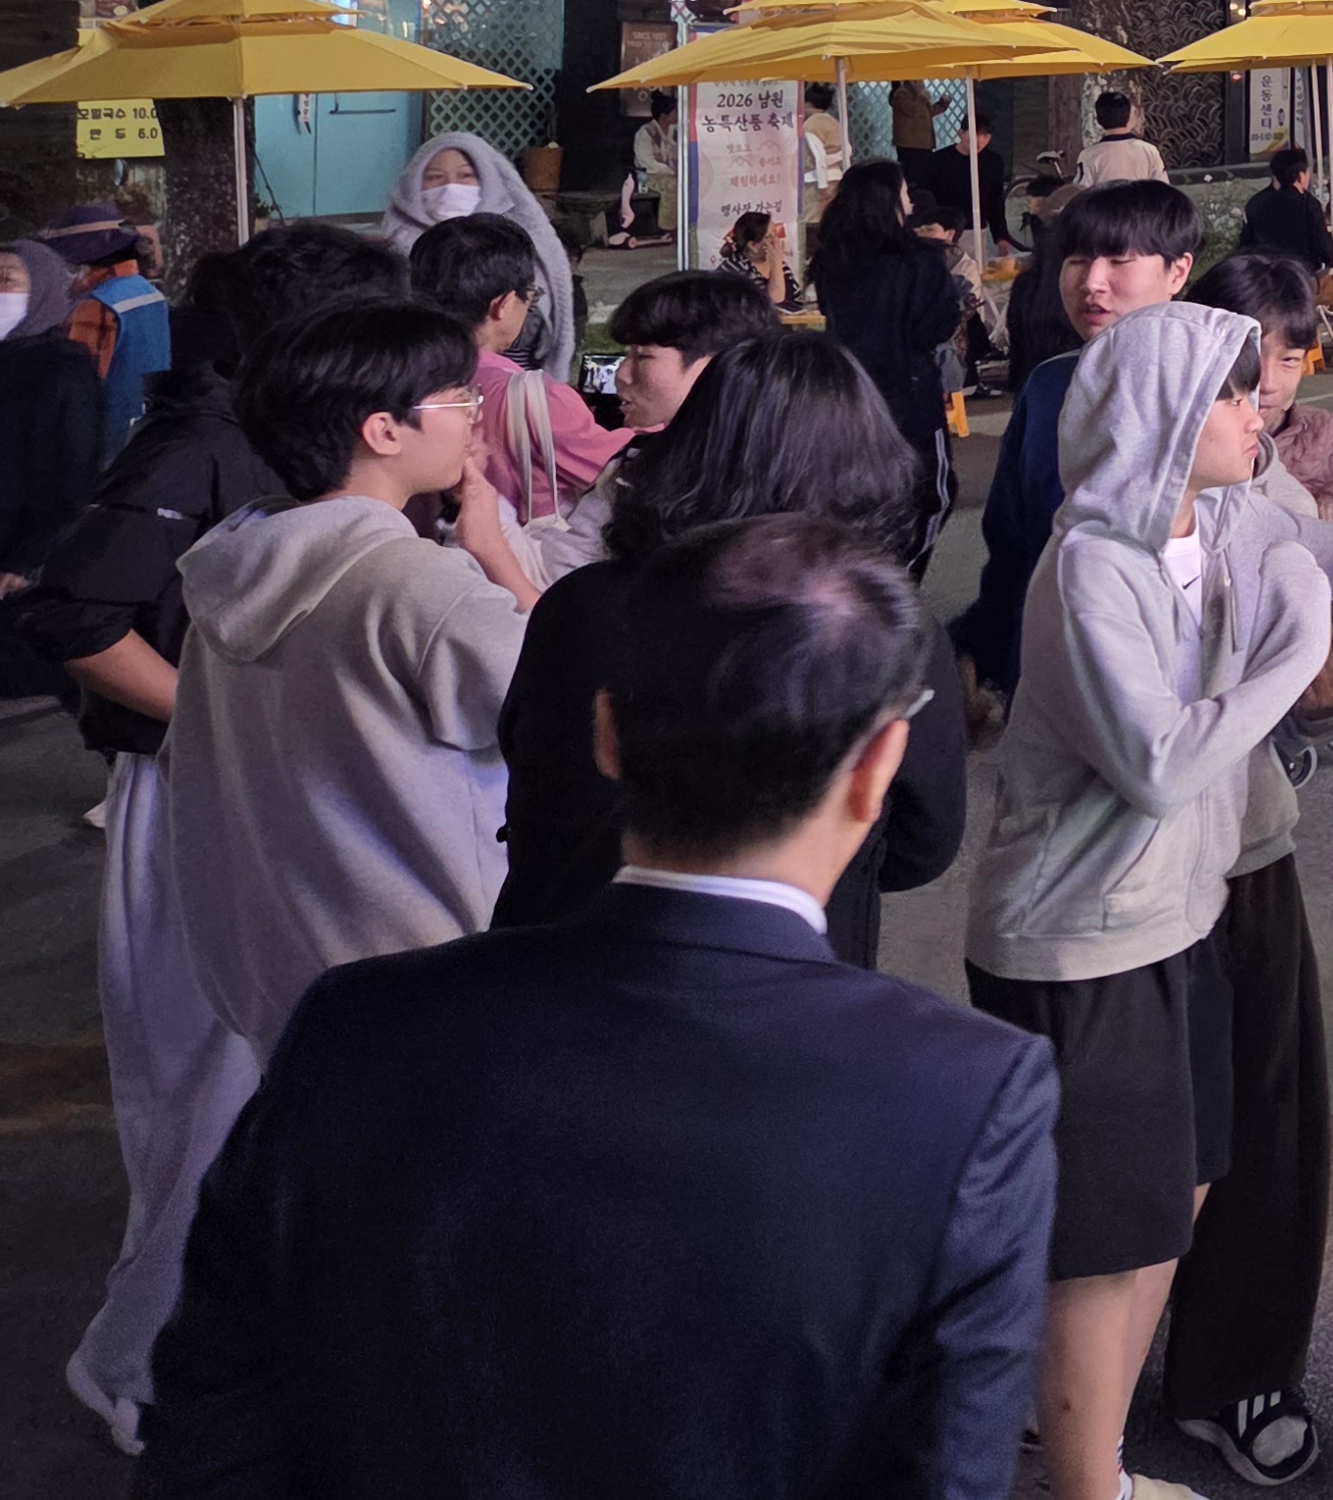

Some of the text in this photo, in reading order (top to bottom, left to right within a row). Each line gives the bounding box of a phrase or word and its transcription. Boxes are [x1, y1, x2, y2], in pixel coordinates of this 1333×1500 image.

[716, 90, 784, 110] 2026 남원
[702, 110, 795, 134] 농특산품 축제
